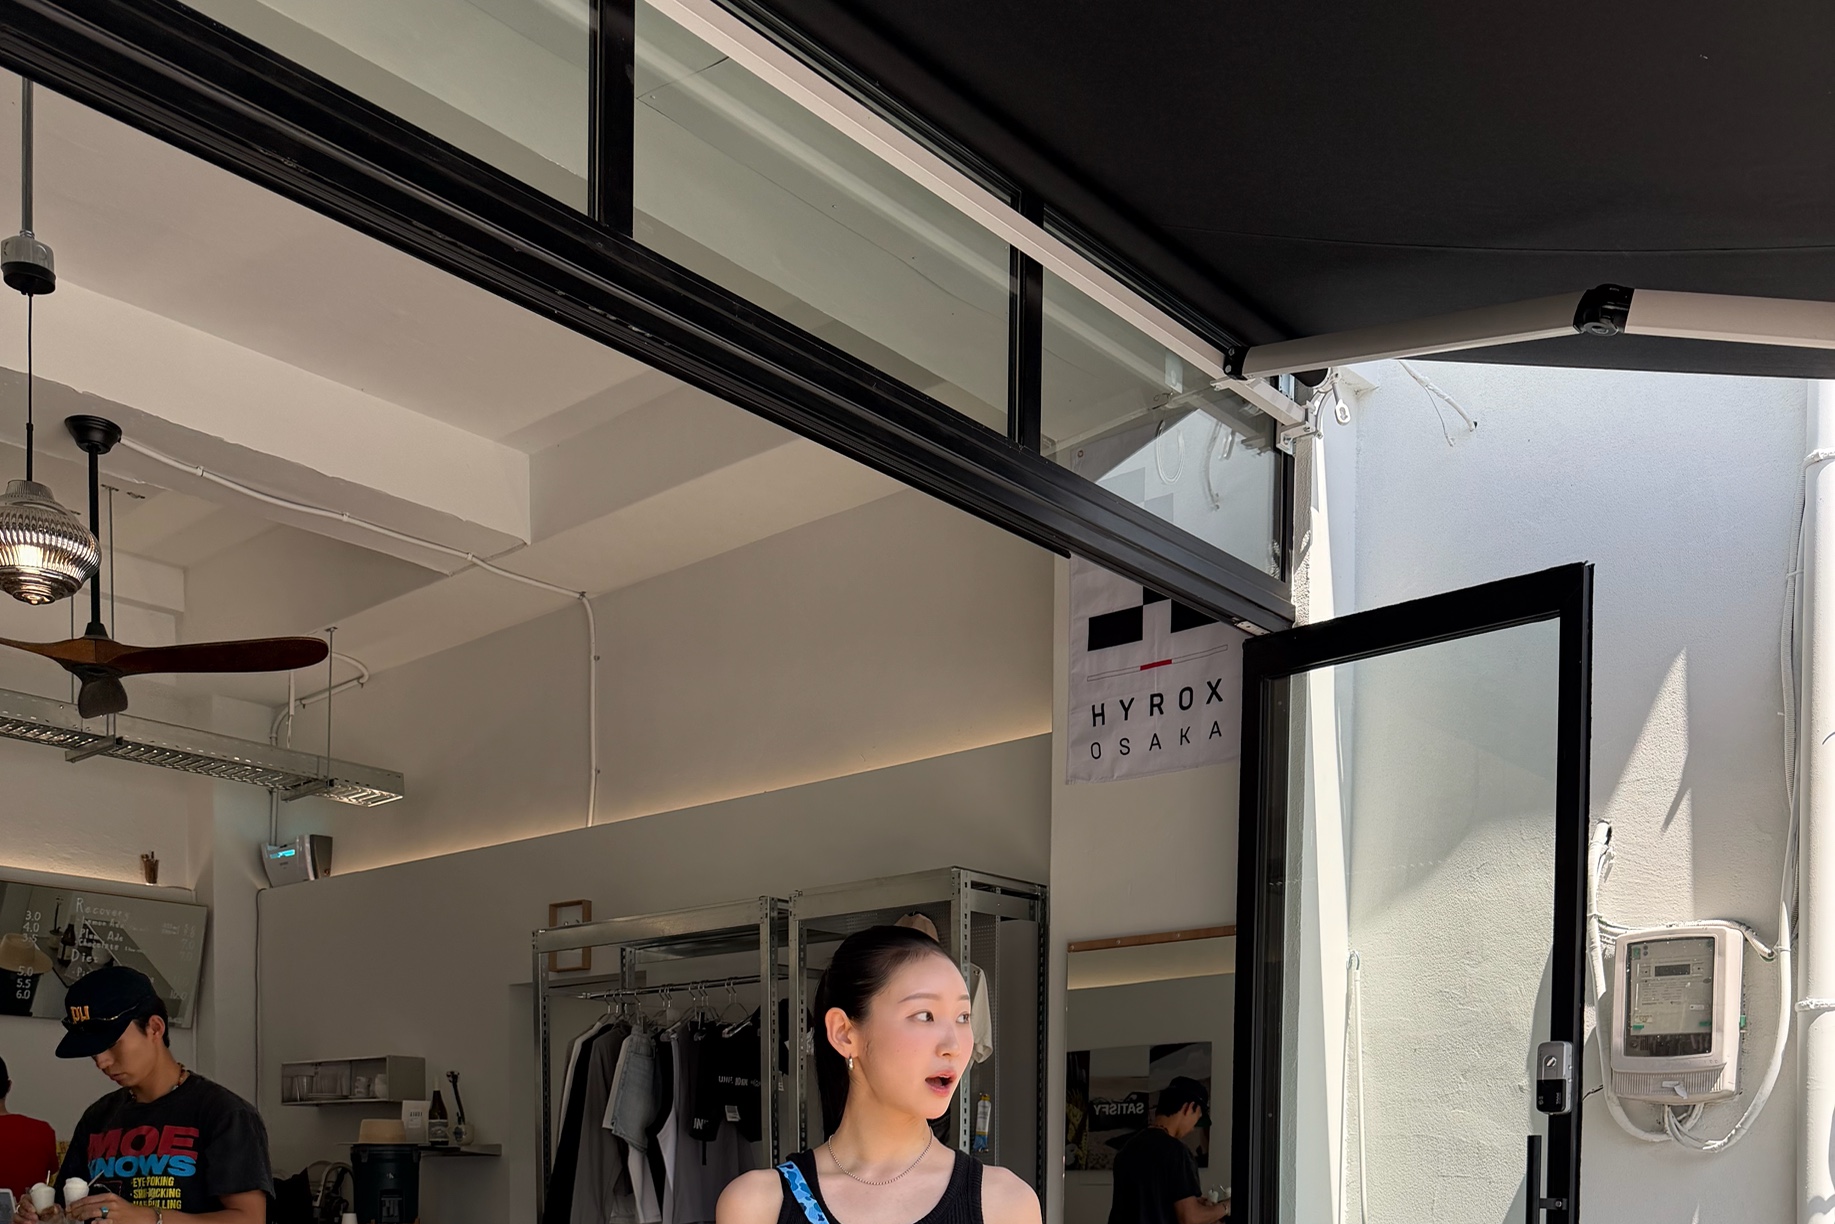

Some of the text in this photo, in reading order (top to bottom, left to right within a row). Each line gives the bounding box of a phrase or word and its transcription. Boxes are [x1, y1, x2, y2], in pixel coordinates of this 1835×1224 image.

[1091, 678, 1223, 727] HYROX
[1090, 720, 1222, 760] OSAKA
[25, 910, 42, 921] 3.0
[22, 922, 40, 933] 4.0
[21, 933, 39, 943] 3.5
[17, 965, 34, 977] 5.0
[16, 978, 32, 989] 5.5
[15, 989, 31, 1000] 6.0
[87, 1125, 199, 1161] MOE
